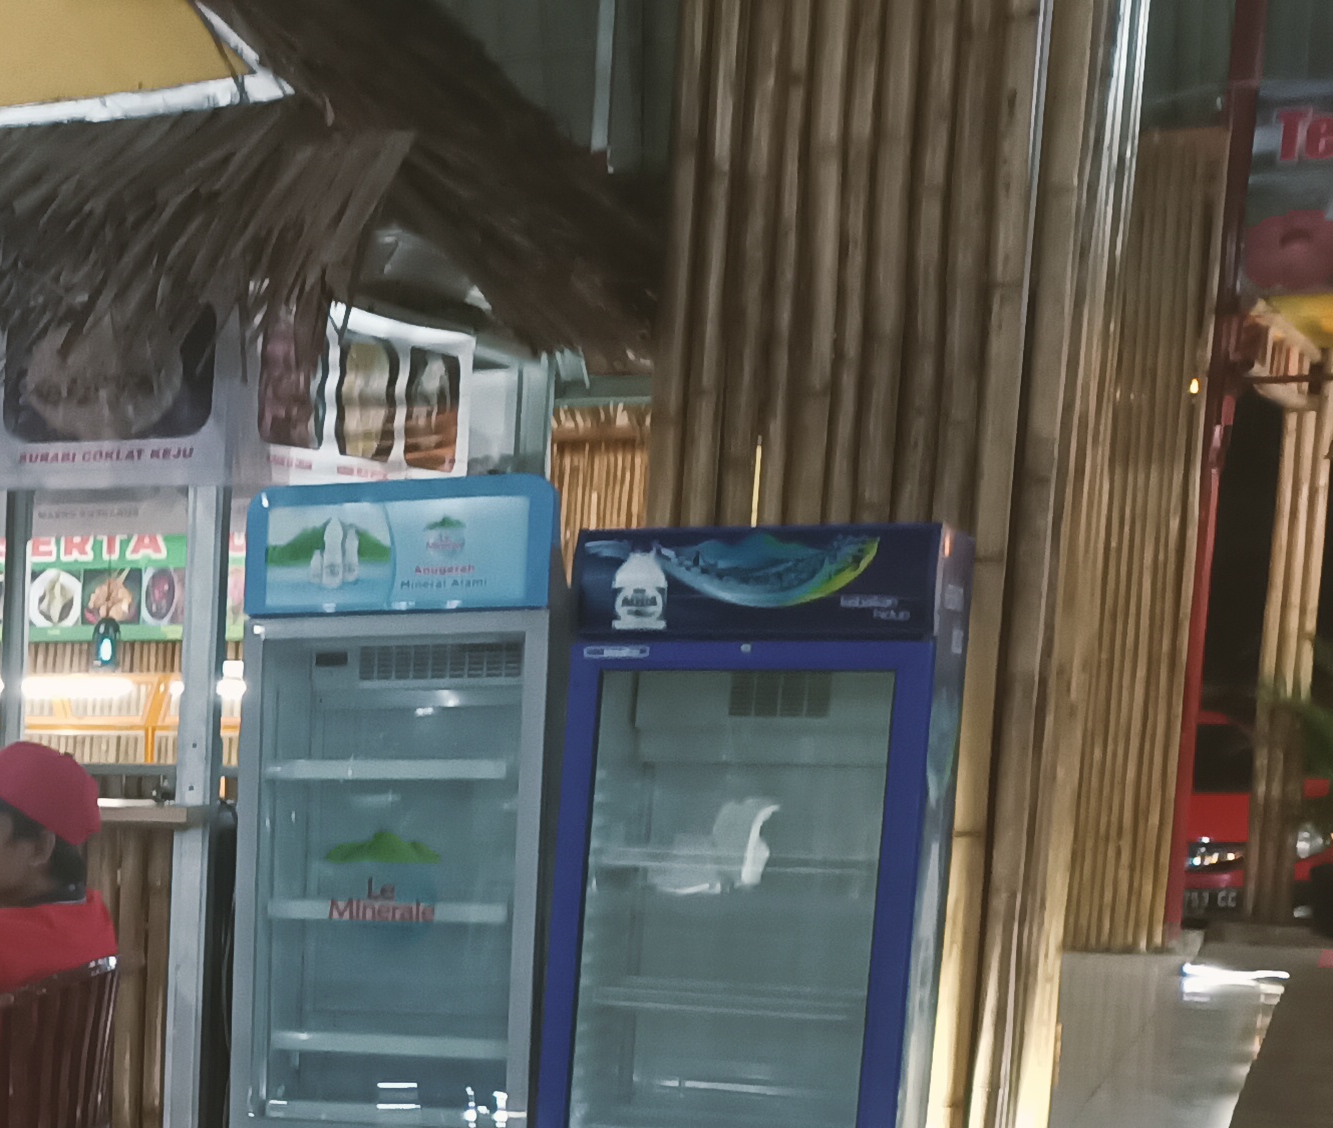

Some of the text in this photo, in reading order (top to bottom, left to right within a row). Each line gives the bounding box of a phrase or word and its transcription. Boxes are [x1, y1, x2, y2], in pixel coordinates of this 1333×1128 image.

[82, 448, 145, 463] COKLAT
[149, 446, 195, 461] KEJU
[367, 876, 395, 900] Le
[328, 897, 435, 921] Minerale
